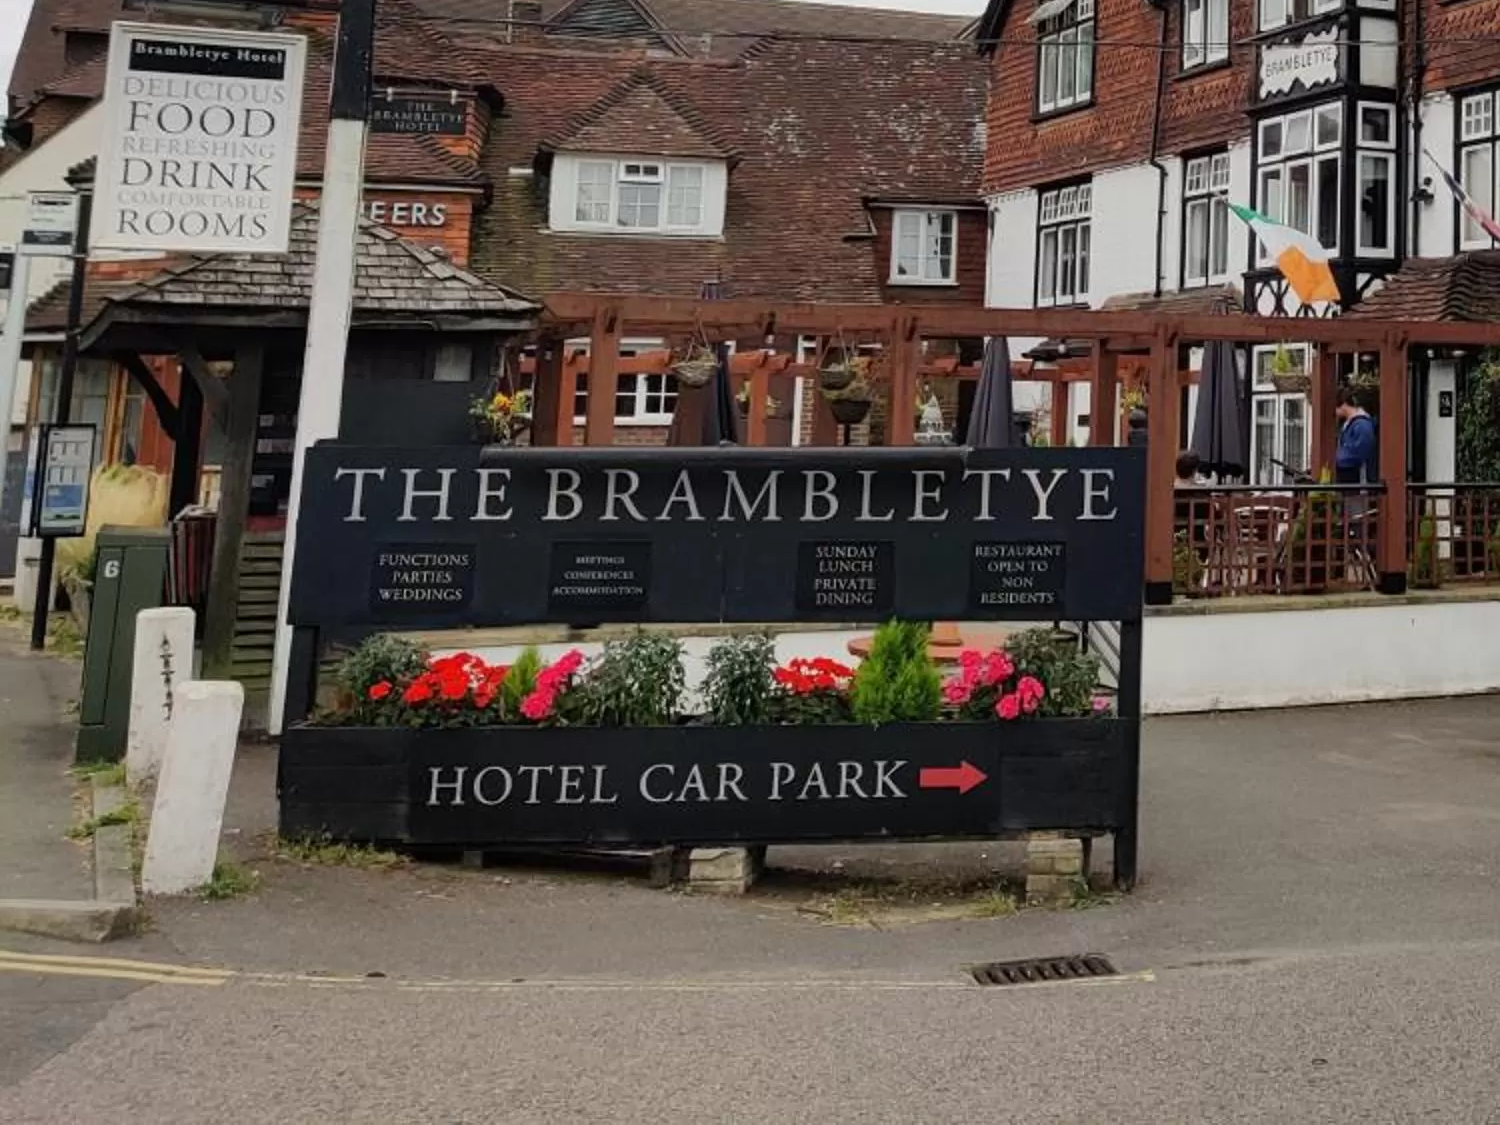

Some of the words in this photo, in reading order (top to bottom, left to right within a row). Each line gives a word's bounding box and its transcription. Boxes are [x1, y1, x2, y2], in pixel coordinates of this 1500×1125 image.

[135, 42, 230, 61] Brambletye
[237, 50, 283, 64] Hotel
[1265, 46, 1332, 77] BRAMBLETYE
[123, 76, 285, 104] DELICIOUS
[406, 102, 434, 112] THE
[128, 100, 275, 139] FOOD
[395, 121, 440, 132] HOTEL
[121, 136, 275, 160] REFRESHING
[120, 157, 272, 192] DRINK
[117, 189, 270, 209] COMFORTABLE
[116, 208, 268, 239] ROOMS
[335, 466, 513, 522] THE
[541, 467, 1119, 522] BRAMBLETYE
[815, 546, 877, 558] SUNDAY
[975, 545, 1064, 557] RESTAURANT
[378, 554, 470, 567] FUNCTIONS
[819, 560, 873, 572] LUNCH
[987, 560, 1025, 572] OPEN
[1029, 560, 1049, 572] TO
[104, 560, 120, 578] 6
[392, 570, 453, 584] PARTIES
[814, 578, 877, 590] PRIVATE
[1002, 576, 1033, 588] NON
[379, 587, 464, 601] WEDDINGS
[815, 592, 873, 605] DINING
[981, 592, 1055, 604] RESIDENTS
[426, 764, 618, 806] HOTEL
[639, 763, 749, 804] CAR
[767, 760, 908, 801] PARK
